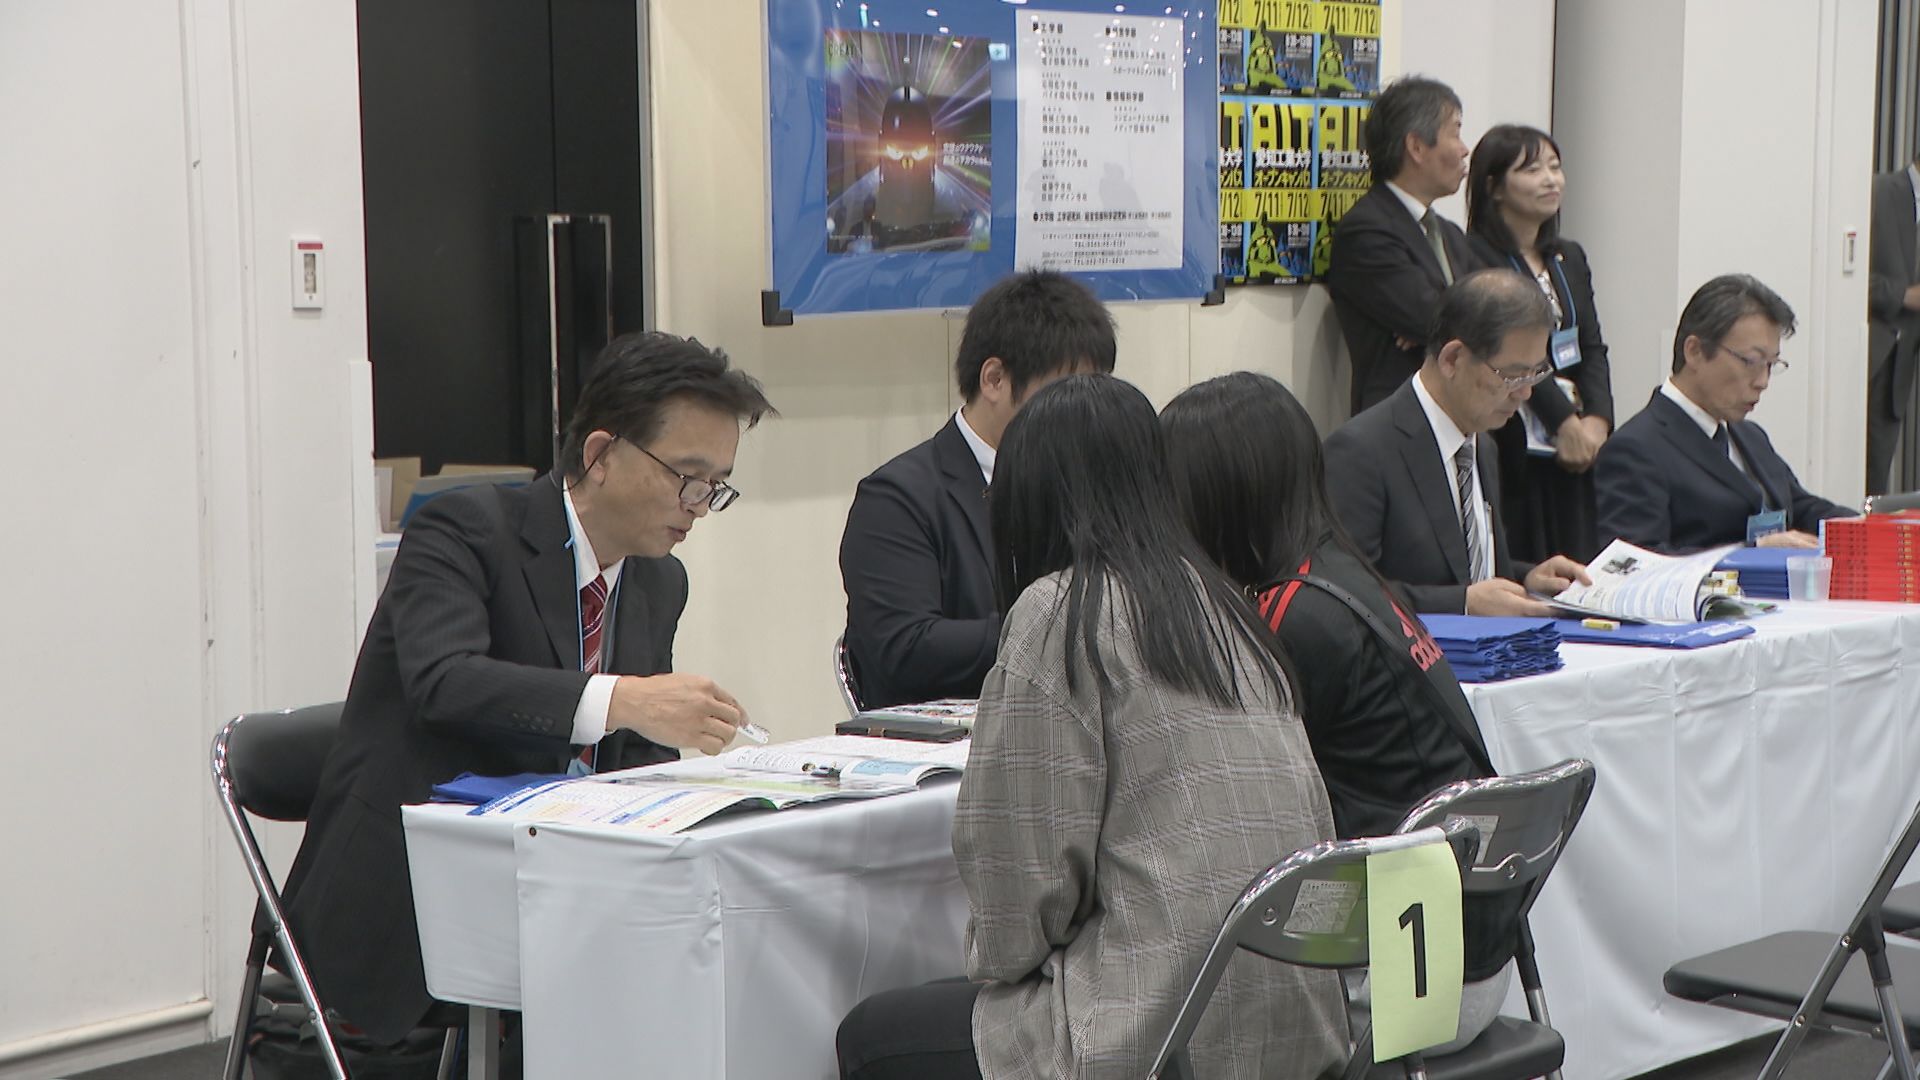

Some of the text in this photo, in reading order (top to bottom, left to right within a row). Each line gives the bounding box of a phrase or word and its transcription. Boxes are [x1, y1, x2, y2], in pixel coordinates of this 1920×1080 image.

[1219, 0, 1240, 24] /12
[1254, 1, 1309, 28] 7/11 7/12
[1323, 5, 1376, 34] 7/11 7/12
[1252, 103, 1315, 151] AIT
[1254, 147, 1312, 168] 愛知工業大学
[1220, 192, 1240, 218] /12
[1255, 192, 1309, 218] 7/11 7/12
[1398, 902, 1428, 1000] 1
